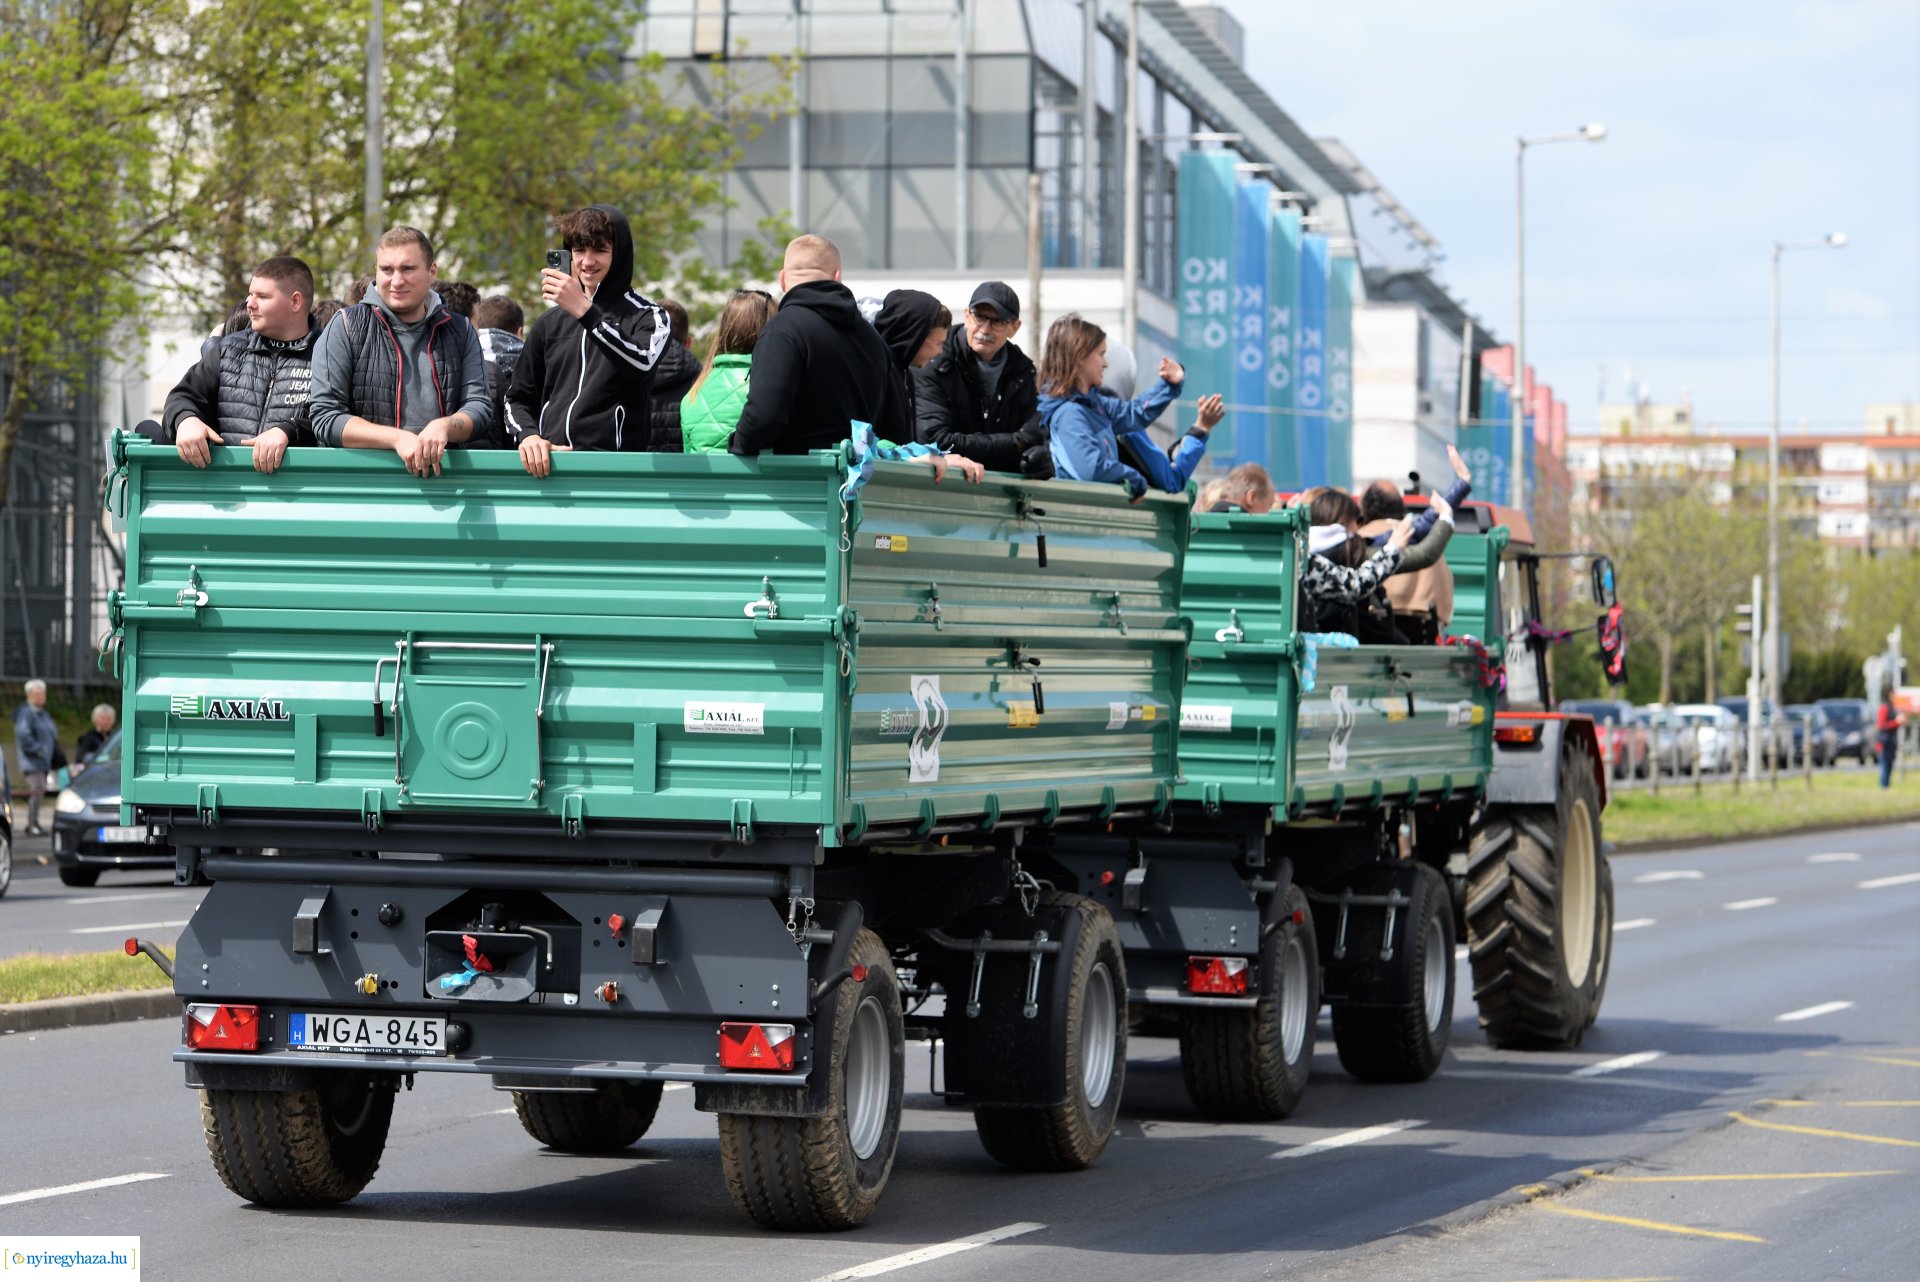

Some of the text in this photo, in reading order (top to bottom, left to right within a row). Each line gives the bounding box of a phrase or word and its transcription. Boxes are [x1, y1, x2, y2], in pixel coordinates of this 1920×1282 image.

[206, 696, 290, 721] AXIÁL
[706, 709, 745, 722] AXIÁL
[293, 1030, 302, 1041] H
[312, 1016, 438, 1047] WGA-845
